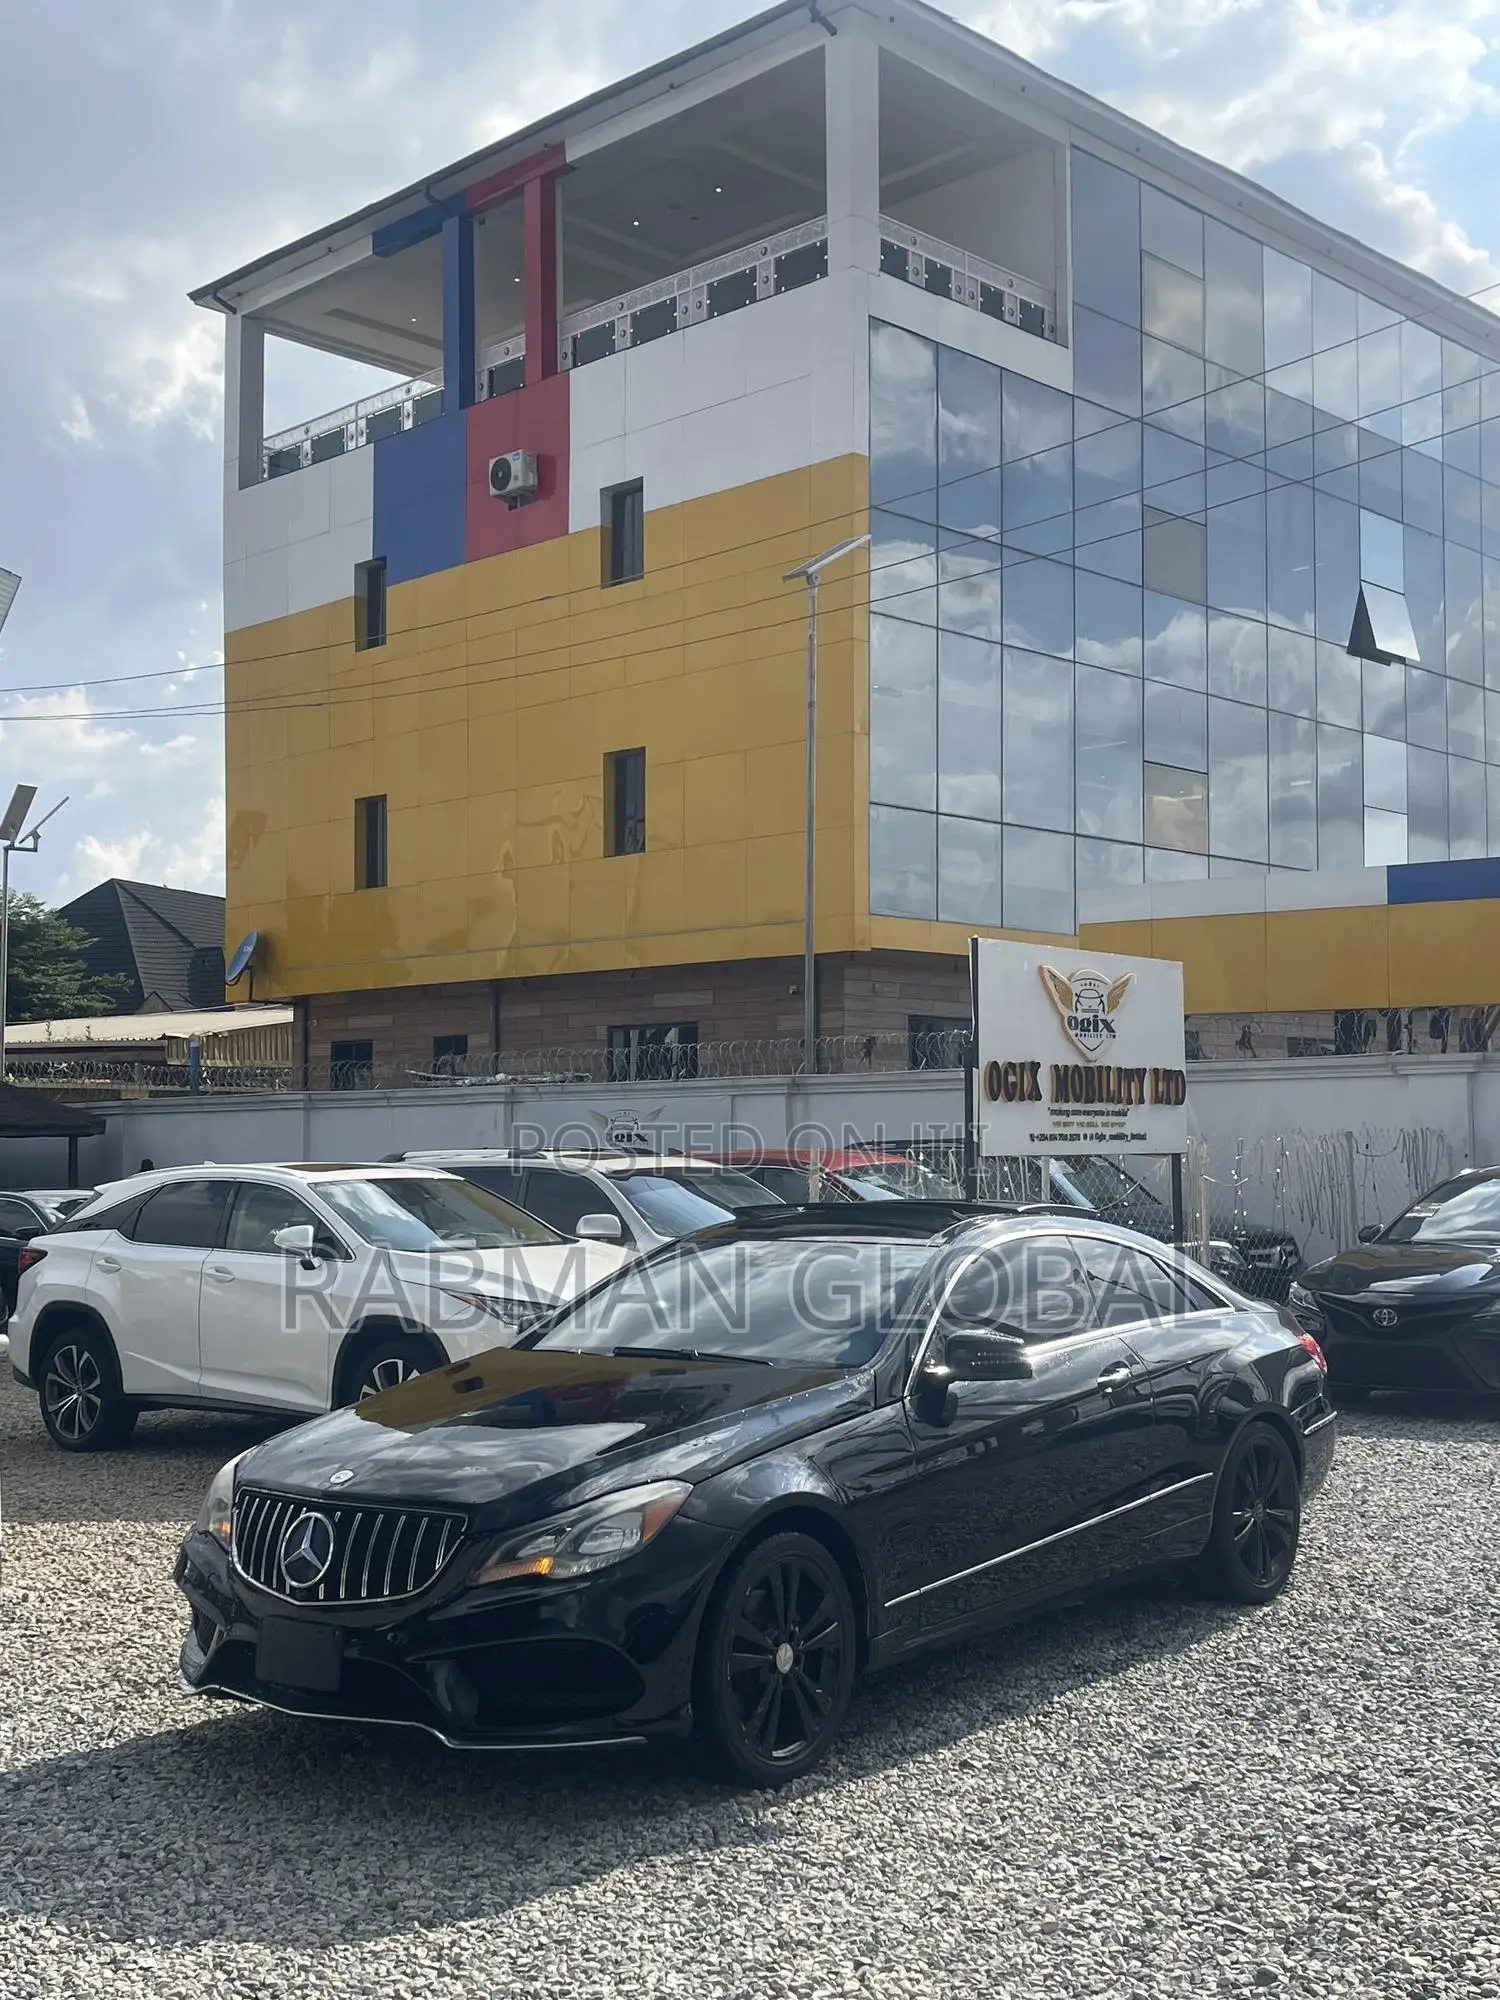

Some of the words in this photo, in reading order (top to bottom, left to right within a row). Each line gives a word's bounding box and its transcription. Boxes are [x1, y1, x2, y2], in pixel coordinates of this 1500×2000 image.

[1067, 1015, 1116, 1033] Ogix
[984, 1061, 1042, 1101] OGIX
[1050, 1064, 1147, 1105] MOBILITY
[1149, 1068, 1187, 1105] LTD
